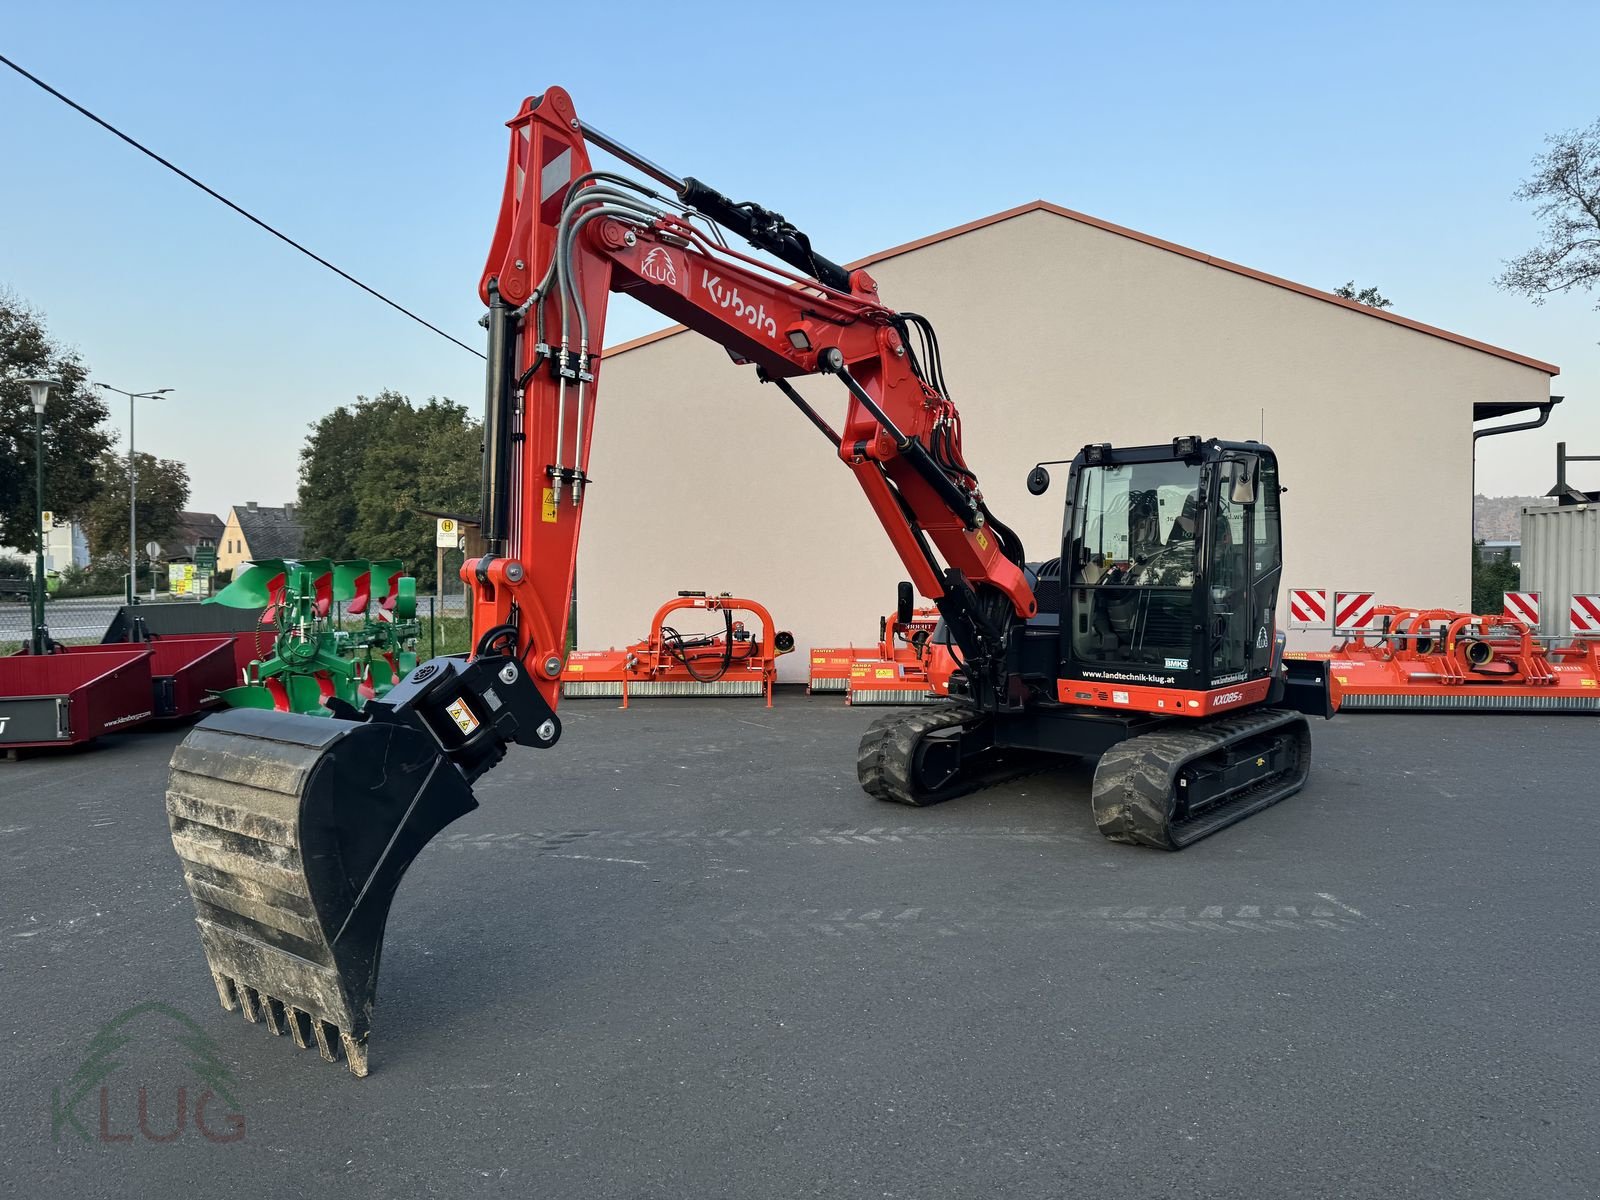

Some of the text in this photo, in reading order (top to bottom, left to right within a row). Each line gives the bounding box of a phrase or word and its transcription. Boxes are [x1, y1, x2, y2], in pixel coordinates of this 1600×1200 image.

[641, 259, 676, 286] KLUG
[702, 269, 777, 338] Kubota
[444, 522, 451, 530] H
[1256, 638, 1268, 649] KLUG
[1165, 659, 1189, 669] BMKS
[1082, 669, 1175, 684] www.landtechnik-klug.at
